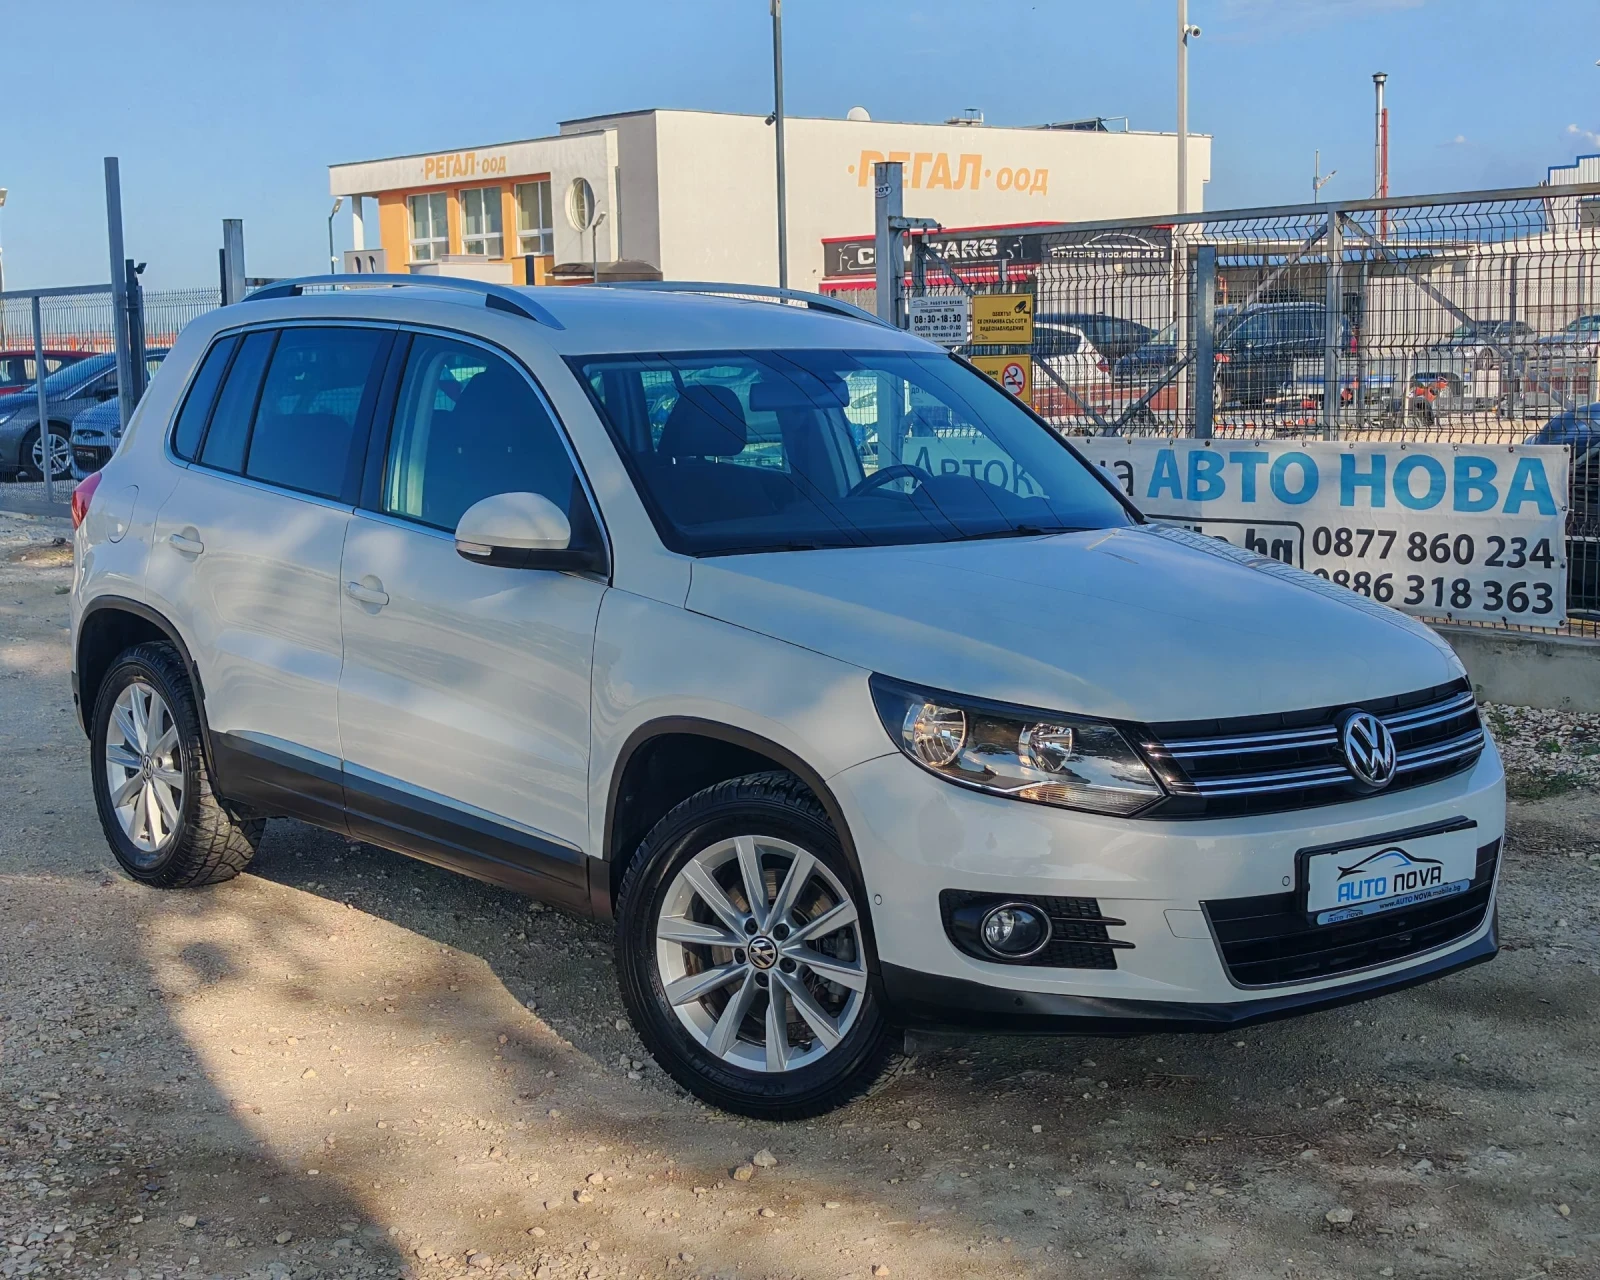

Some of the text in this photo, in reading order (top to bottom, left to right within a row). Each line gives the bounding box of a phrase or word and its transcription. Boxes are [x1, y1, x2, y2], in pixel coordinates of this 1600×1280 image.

[425, 152, 476, 180] РЕГАЛ
[1146, 448, 1319, 505] АВТО
[1340, 453, 1557, 516] НОВА
[1312, 526, 1397, 559] 0877
[1406, 531, 1475, 565] 860
[1484, 535, 1555, 569] 234
[1403, 574, 1472, 609] 318
[1482, 580, 1554, 614] 363
[1337, 866, 1442, 903] AUTO NOVA
